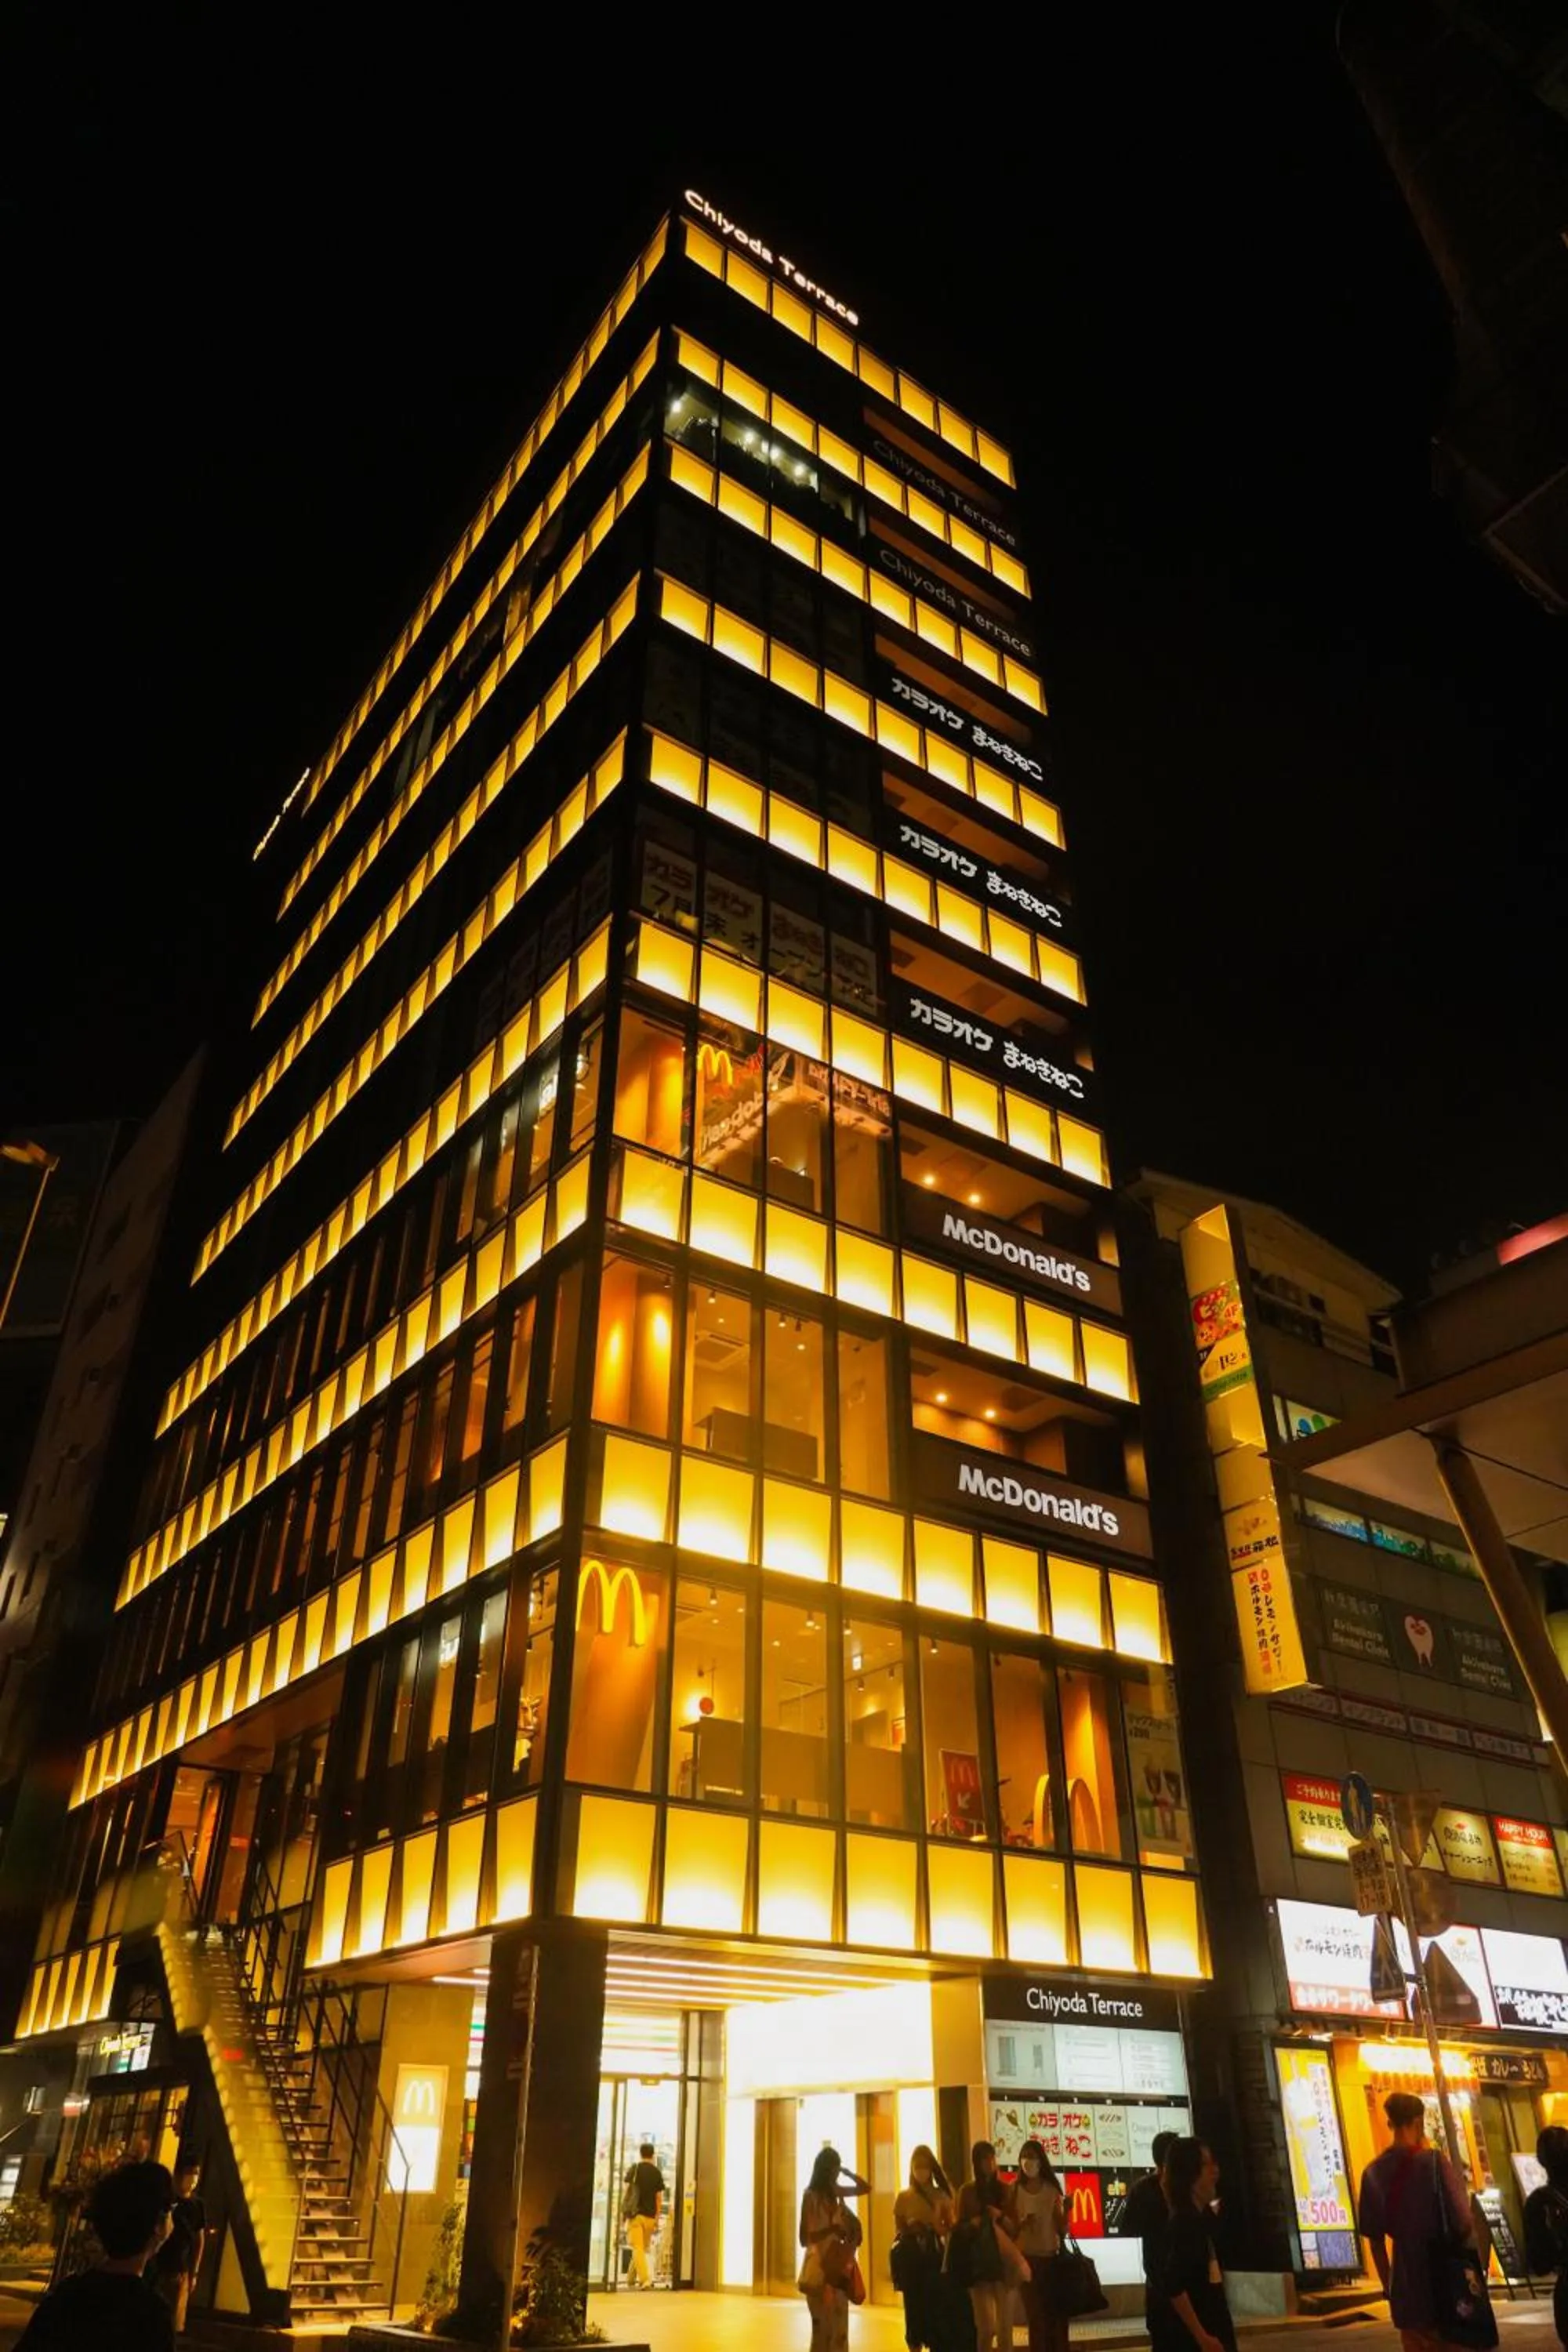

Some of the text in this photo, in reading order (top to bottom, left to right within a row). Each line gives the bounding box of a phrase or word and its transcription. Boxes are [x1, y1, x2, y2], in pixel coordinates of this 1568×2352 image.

[684, 189, 859, 326] Chiyoda Terrace
[873, 440, 1016, 546] Chiyoda Terrace
[880, 549, 1032, 656] Chiyoda Terrace
[892, 677, 1043, 780] カラオケ まねきねこ
[900, 824, 1063, 927] カラオケ まねきねこ
[910, 998, 1085, 1099] カラオケ まねきねこ
[942, 1214, 1091, 1292] McDonald's
[959, 1463, 1119, 1537] McDonald's
[1026, 1987, 1144, 2017] Chiyoda Terrace
[1038, 2113, 1082, 2129] カラオケ
